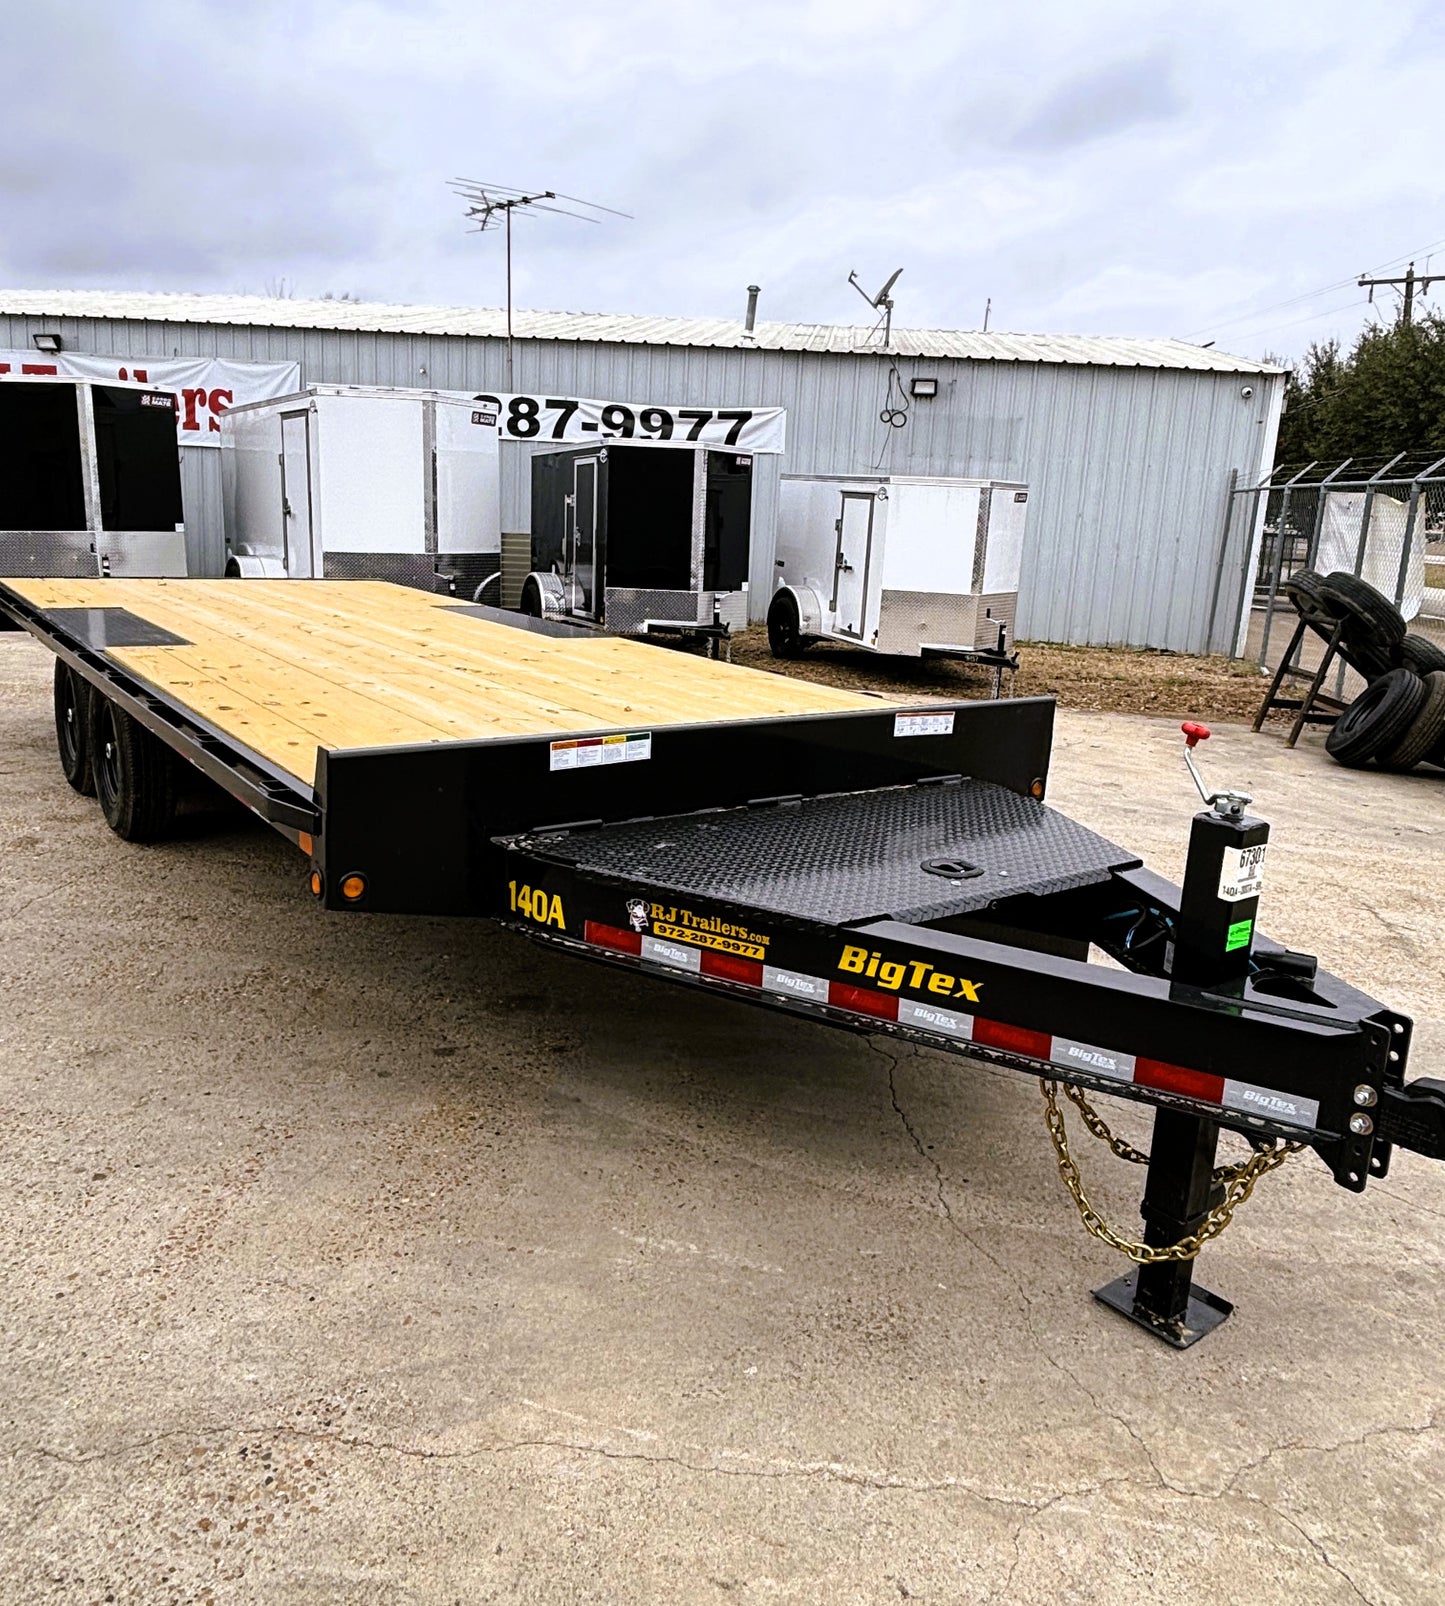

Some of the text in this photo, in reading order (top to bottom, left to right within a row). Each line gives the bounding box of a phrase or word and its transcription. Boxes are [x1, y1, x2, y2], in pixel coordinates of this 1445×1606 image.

[1239, 846, 1266, 869] 67301
[508, 880, 566, 930] 140A
[650, 903, 678, 922] RJ
[658, 924, 760, 956] 972-287-9977
[776, 973, 816, 990] BigTex
[837, 945, 984, 1003] BigTex
[913, 1007, 958, 1027] BigTex
[1067, 1046, 1117, 1067] BigTex
[1243, 1090, 1297, 1111] BigTex
